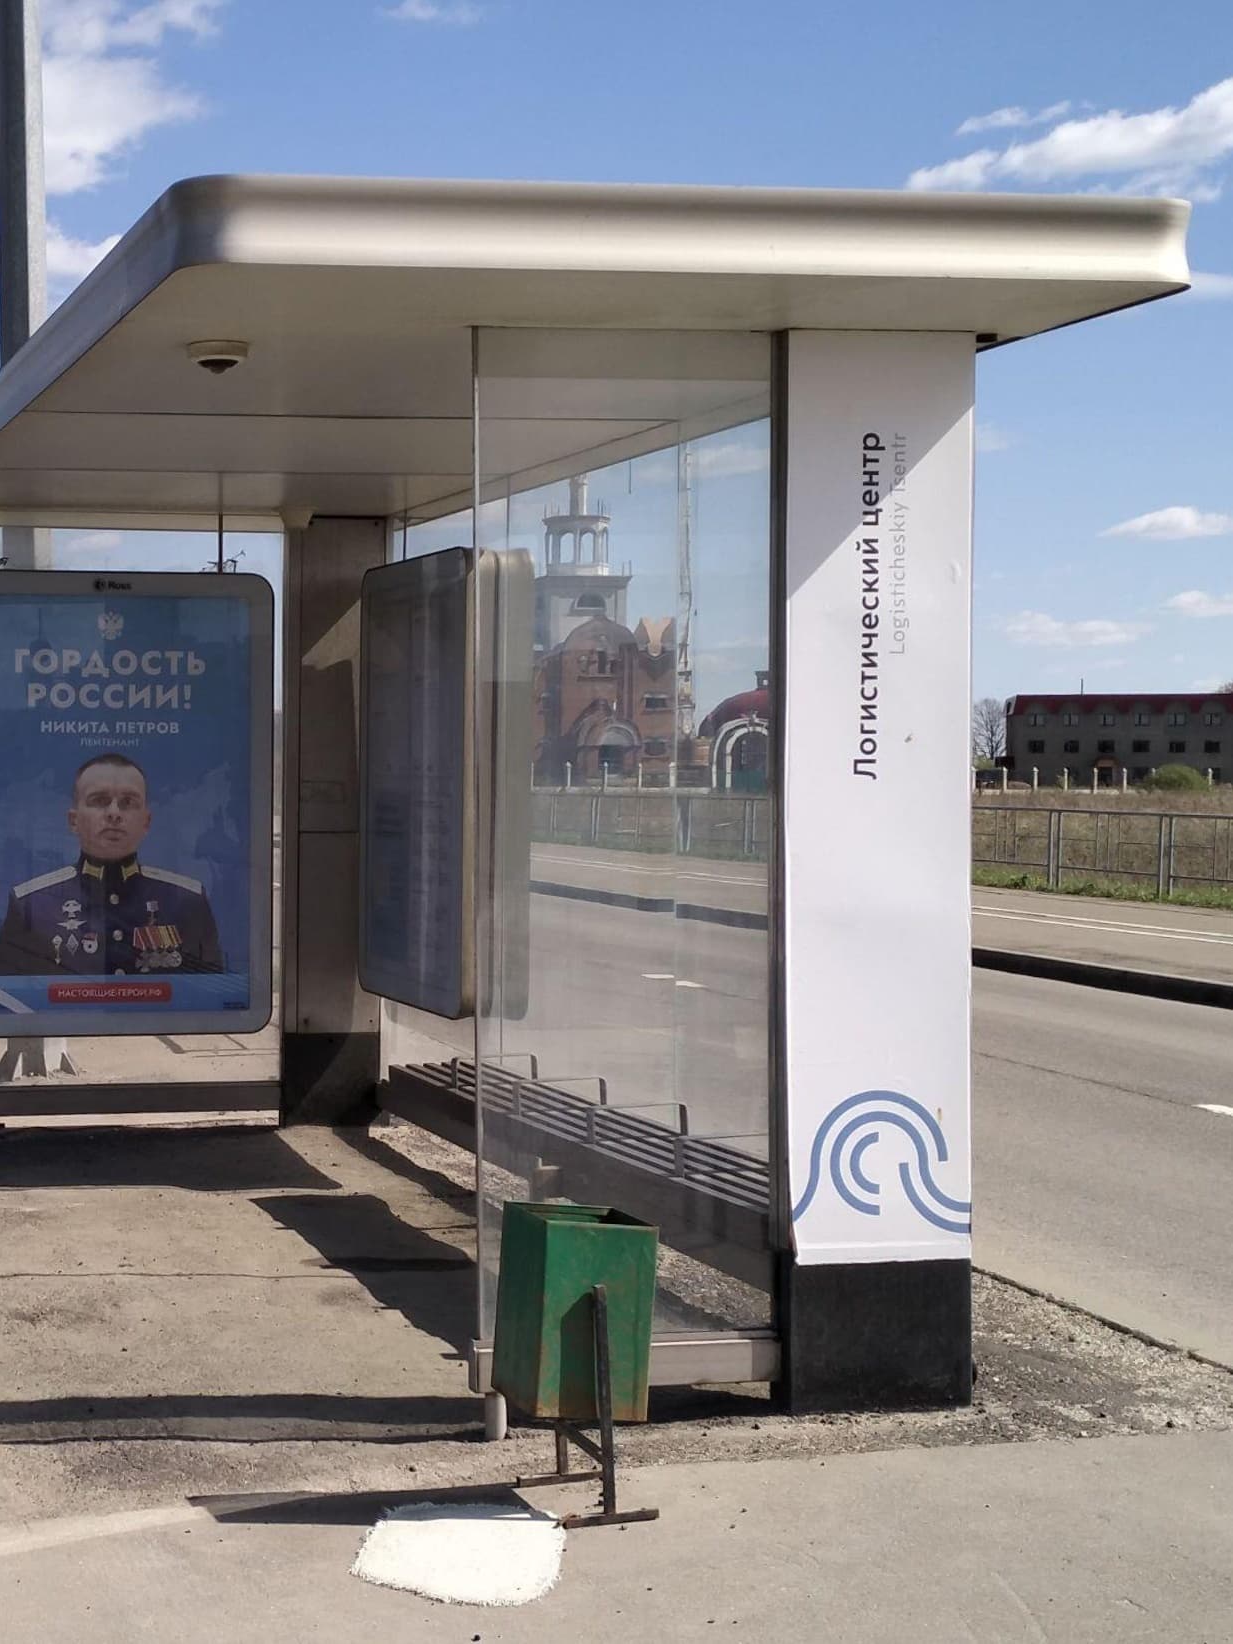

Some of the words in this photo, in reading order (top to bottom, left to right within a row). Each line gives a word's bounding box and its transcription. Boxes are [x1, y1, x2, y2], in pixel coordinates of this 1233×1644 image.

[862, 432, 886, 526] центр
[888, 432, 907, 496] Tsentr
[888, 502, 910, 655] Logisticheskiy
[15, 648, 206, 677] ГОРДОСТЬ
[853, 538, 879, 780] Логистический
[27, 682, 192, 709] РОССИИ!
[40, 720, 109, 734] НИКИТА
[116, 721, 180, 734] ПЕТРОВ
